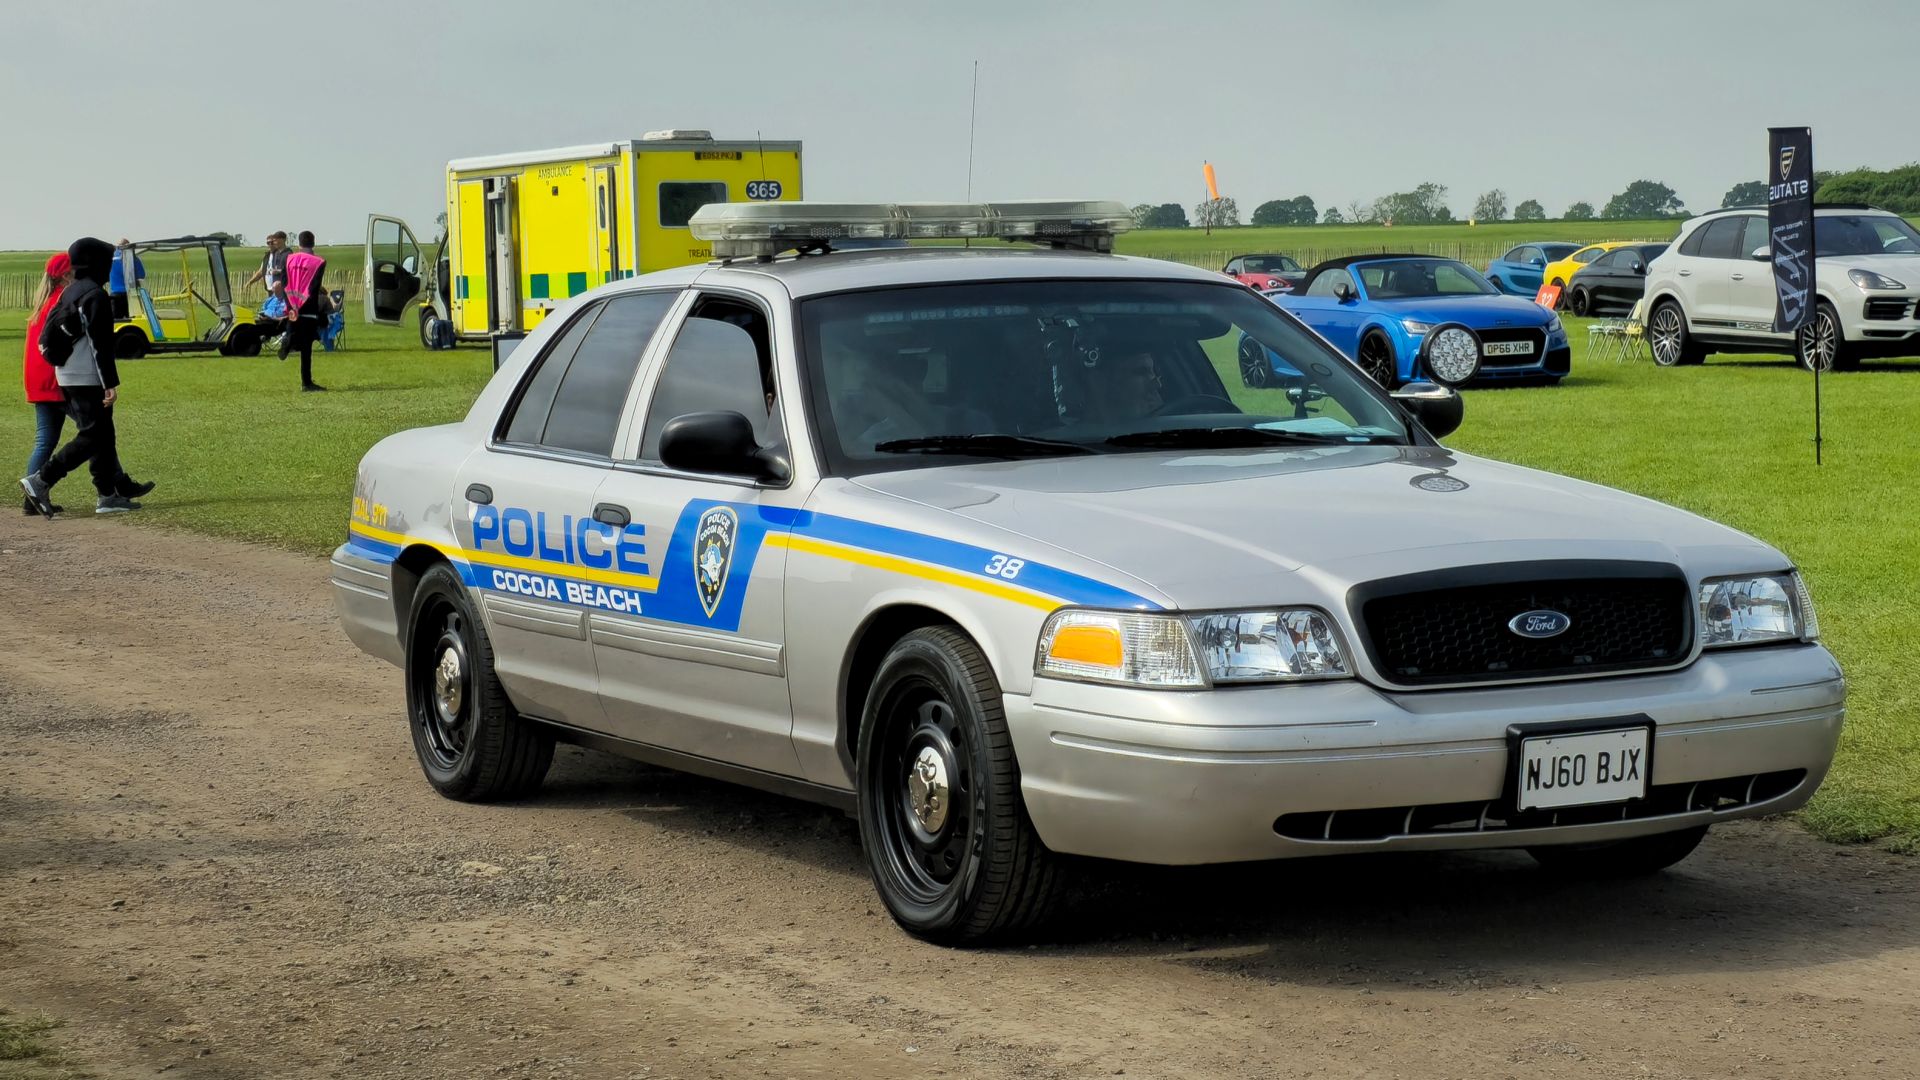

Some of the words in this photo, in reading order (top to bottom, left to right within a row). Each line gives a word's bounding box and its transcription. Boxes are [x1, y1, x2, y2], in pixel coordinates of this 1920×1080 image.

[748, 182, 778, 198] 365
[1487, 344, 1511, 354] DP66
[1513, 343, 1530, 353] XHR
[707, 513, 731, 530] POLICE
[472, 504, 650, 575] POLICE
[985, 555, 1025, 579] 38
[492, 570, 562, 600] COCOA
[566, 582, 643, 614] BEACH
[1525, 615, 1556, 632] Ford
[1527, 754, 1586, 791] NJ60
[1596, 748, 1641, 784] BJX
